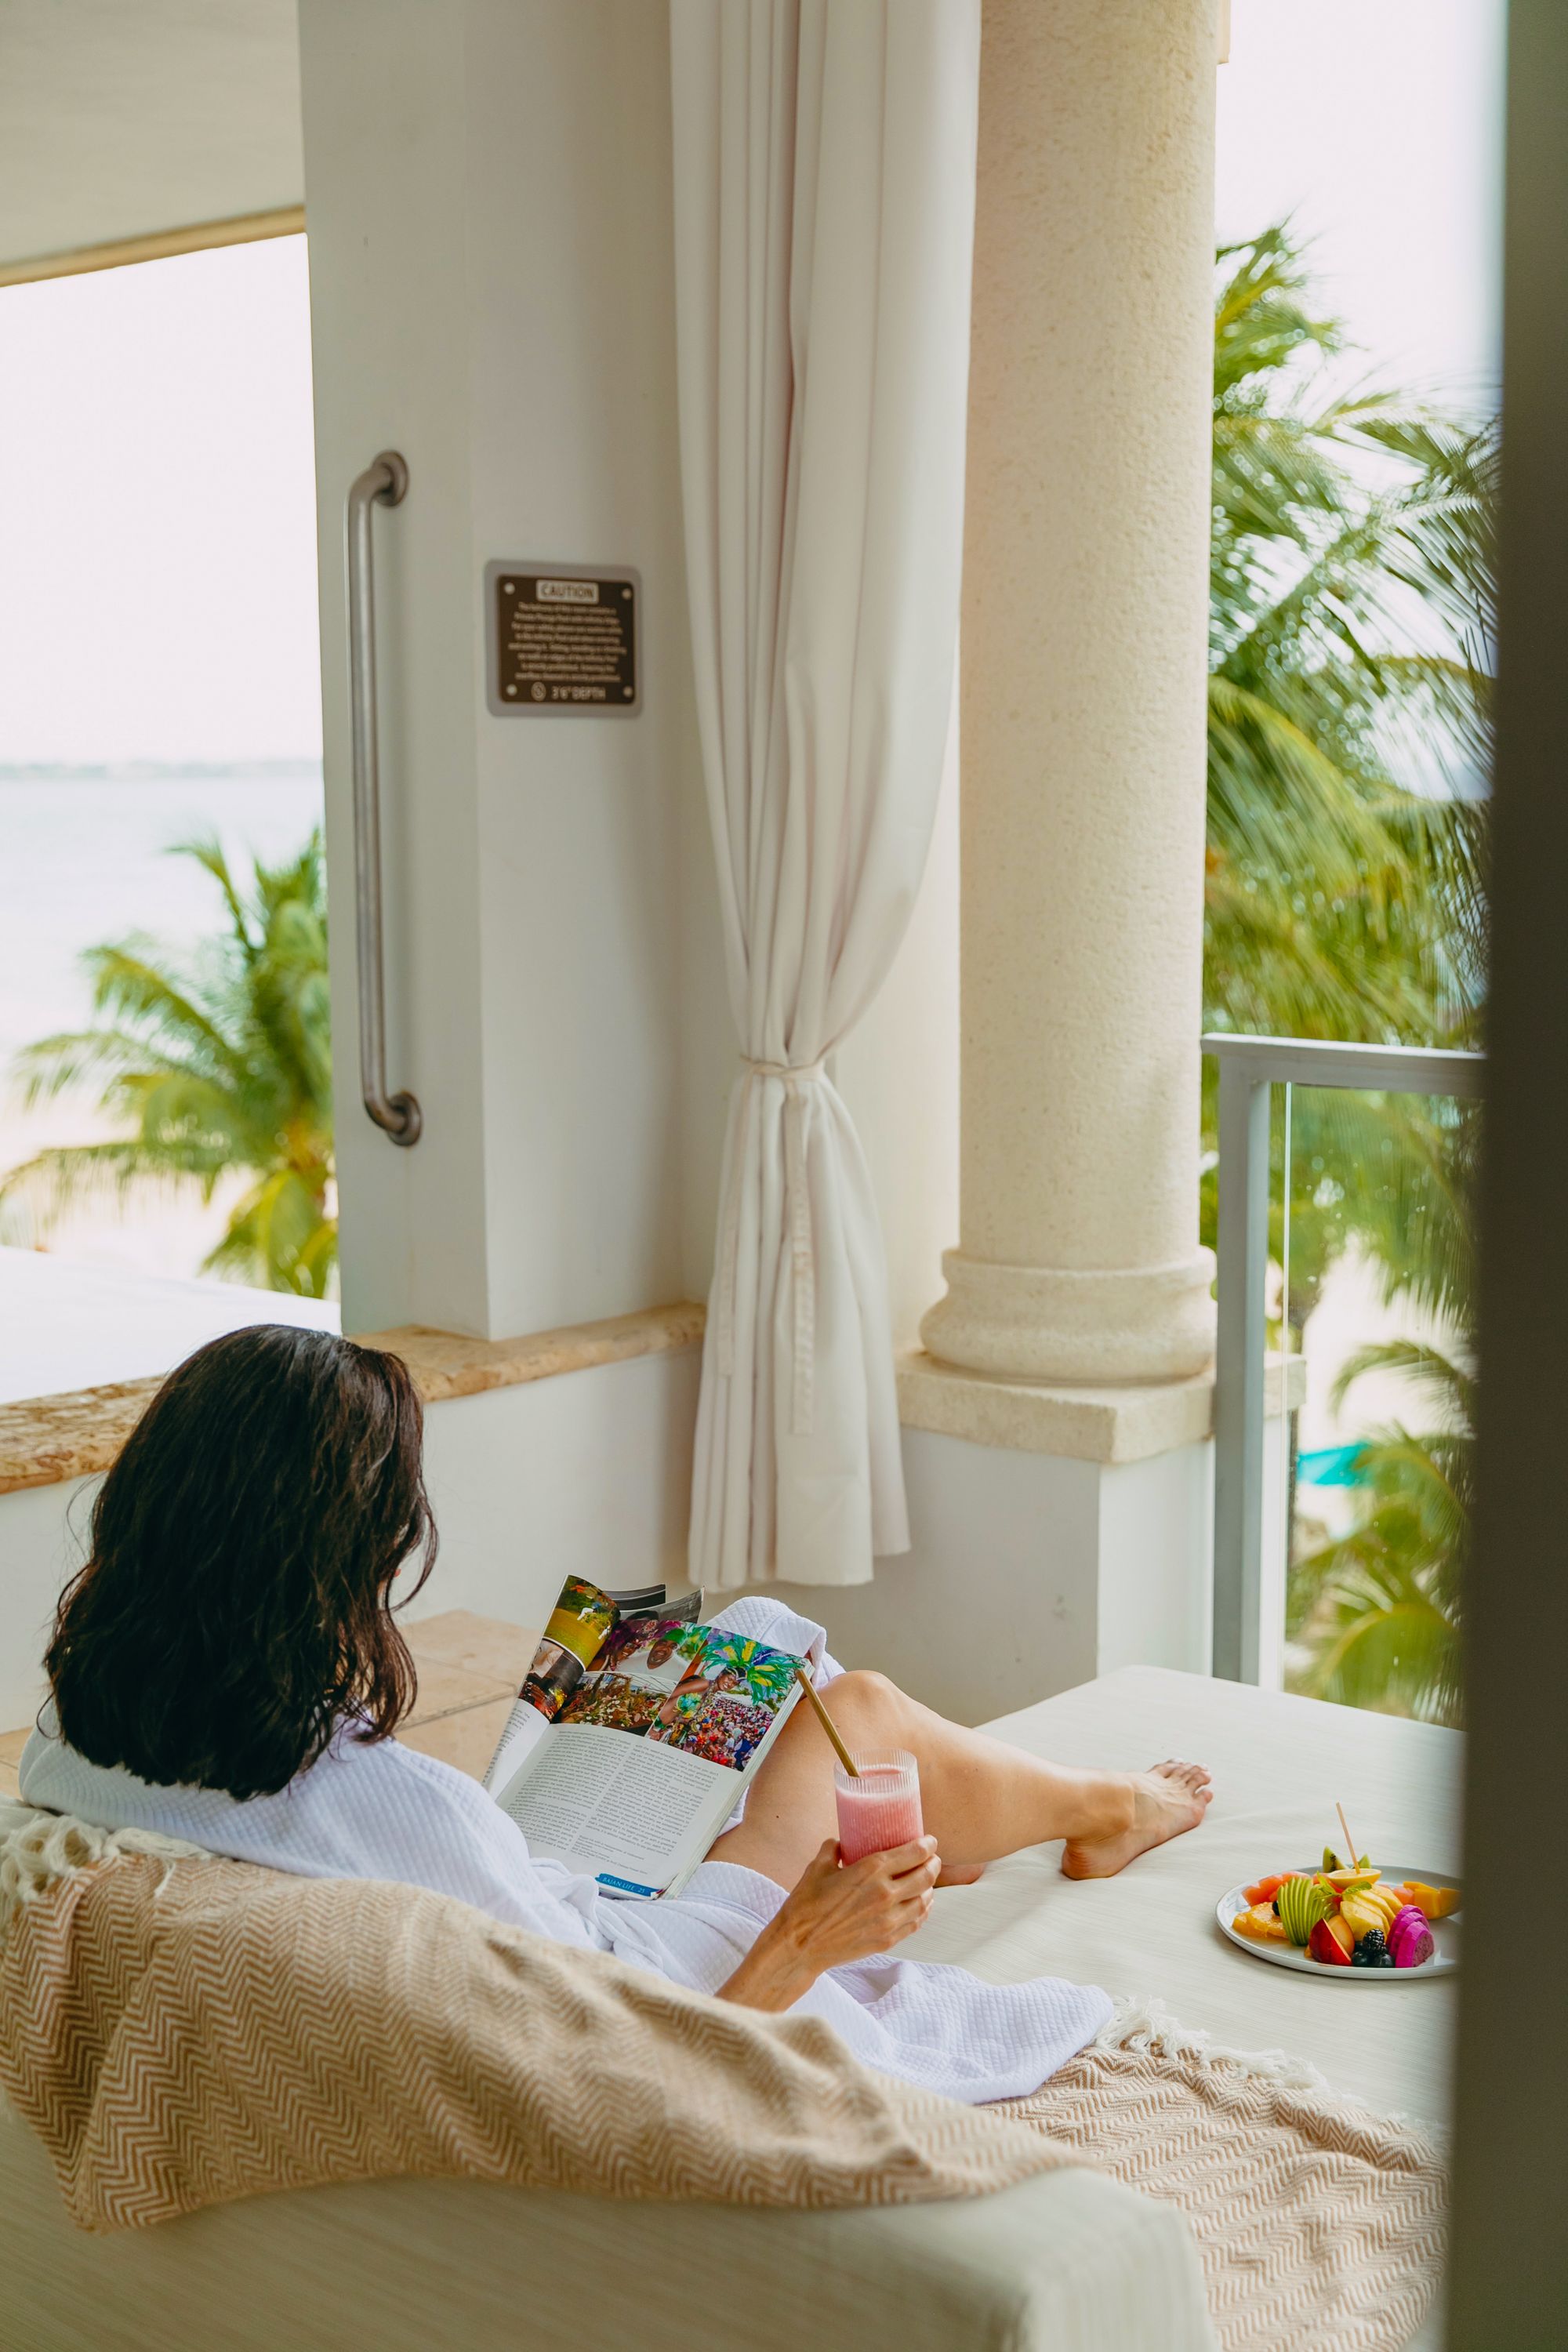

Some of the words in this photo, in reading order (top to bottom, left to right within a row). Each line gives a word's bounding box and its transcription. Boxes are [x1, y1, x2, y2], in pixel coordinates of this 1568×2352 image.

[540, 583, 594, 599] CAUTION
[572, 687, 606, 700] DEPTH
[602, 1877, 622, 1887] BAJAN
[622, 1882, 635, 1891] LIFE
